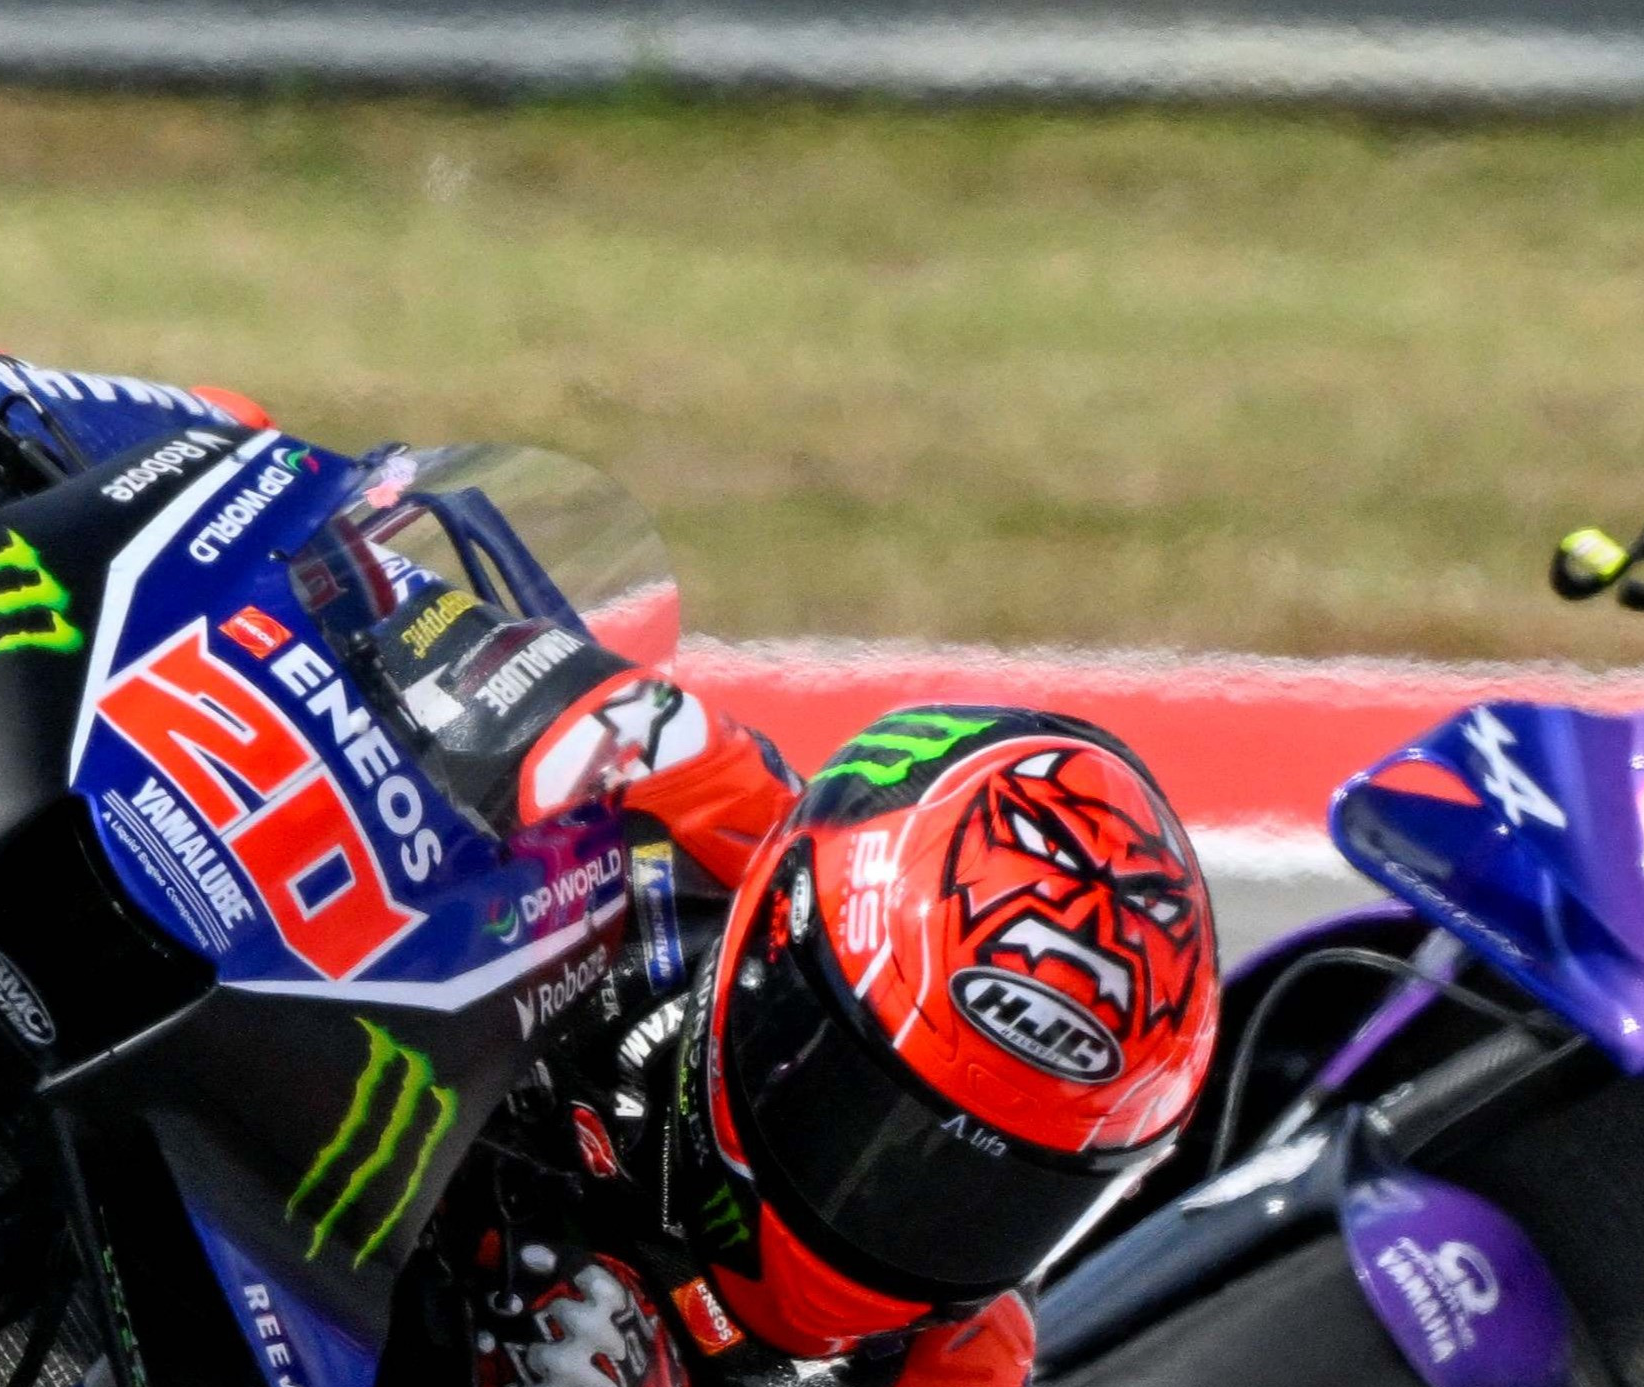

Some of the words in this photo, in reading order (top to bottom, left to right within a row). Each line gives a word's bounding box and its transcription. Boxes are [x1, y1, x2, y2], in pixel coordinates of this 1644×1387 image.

[100, 439, 207, 502] Roboze
[265, 465, 296, 497] DP
[189, 489, 275, 563] WORLD
[233, 616, 276, 649] ENEOS
[94, 616, 429, 982] 20
[270, 642, 442, 883] ENEOS
[111, 820, 141, 856] Liquid
[137, 853, 167, 888] Engine
[164, 886, 210, 949] Component
[131, 776, 257, 930] YAMALUBE
[519, 888, 559, 924] DP
[554, 849, 622, 911] WORLD
[846, 829, 890, 954] BS
[540, 944, 608, 1025] Roboze
[964, 980, 1109, 1071] HJC
[695, 1281, 734, 1344] ENEOS
